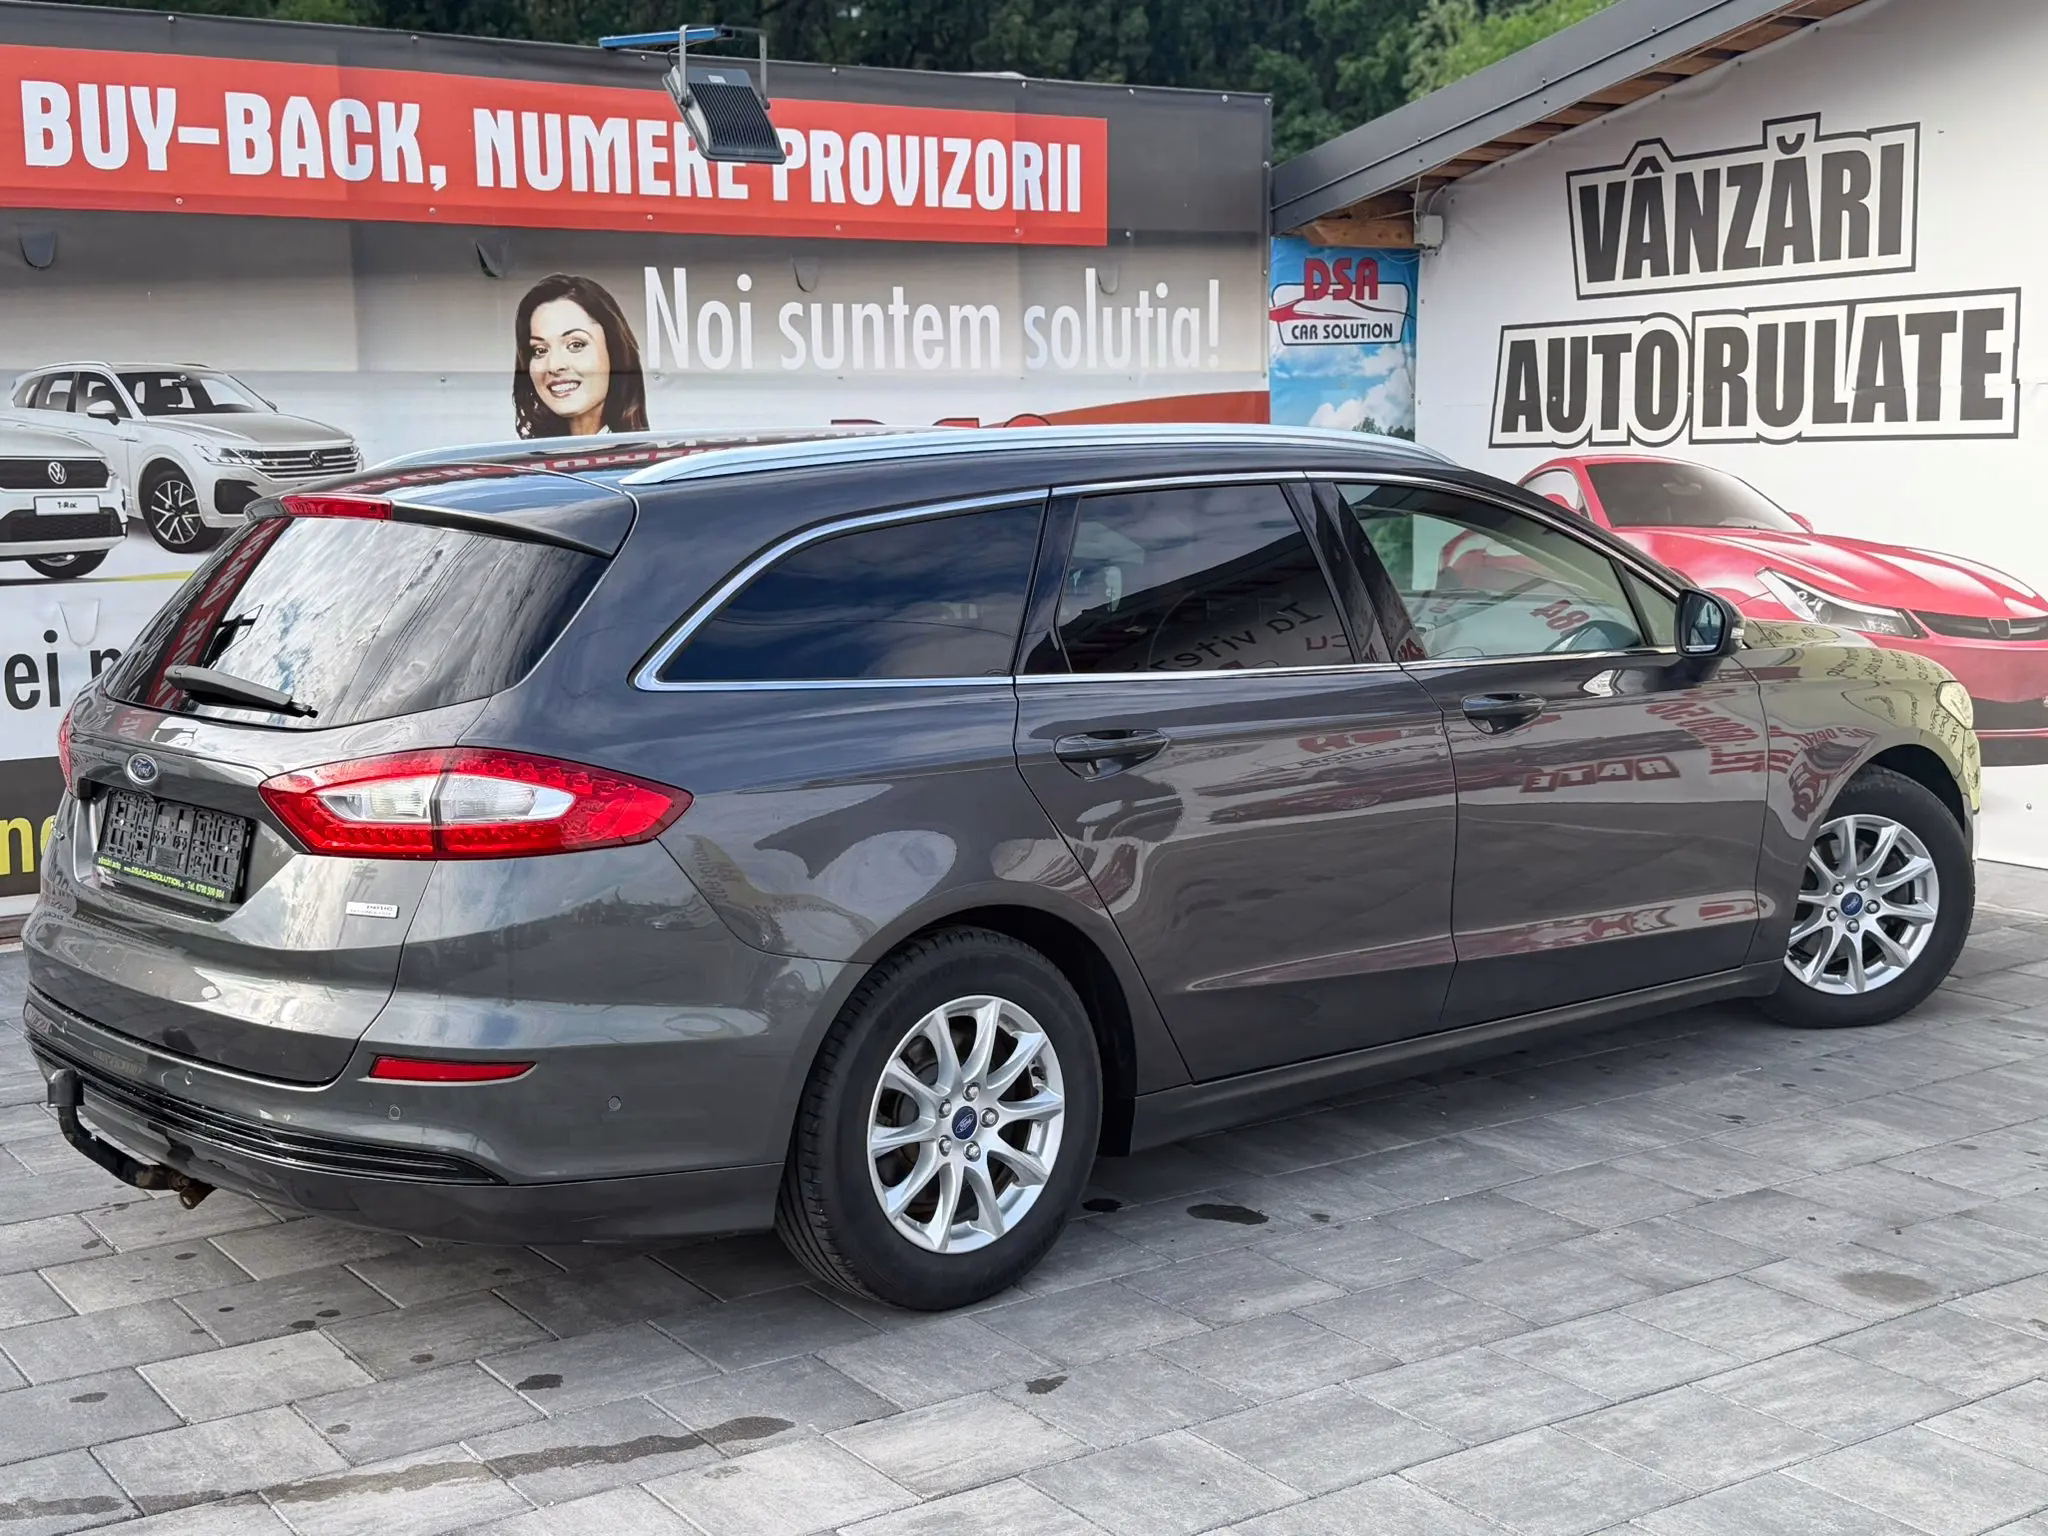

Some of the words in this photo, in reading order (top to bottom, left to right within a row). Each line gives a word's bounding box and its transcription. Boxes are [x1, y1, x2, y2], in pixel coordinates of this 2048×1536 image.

[21, 80, 447, 192] BUY-BACK,
[772, 127, 1081, 213] PROVIZORII
[1579, 133, 1905, 283] VÂNZĂRI
[644, 266, 753, 370] Noi
[779, 286, 1001, 370] suntem
[1291, 324, 1318, 340] CAR
[1323, 323, 1393, 339] SOLUTION
[1304, 257, 1379, 301] DSA
[1501, 329, 1679, 433] AUTO
[1702, 307, 2004, 428] RULATE
